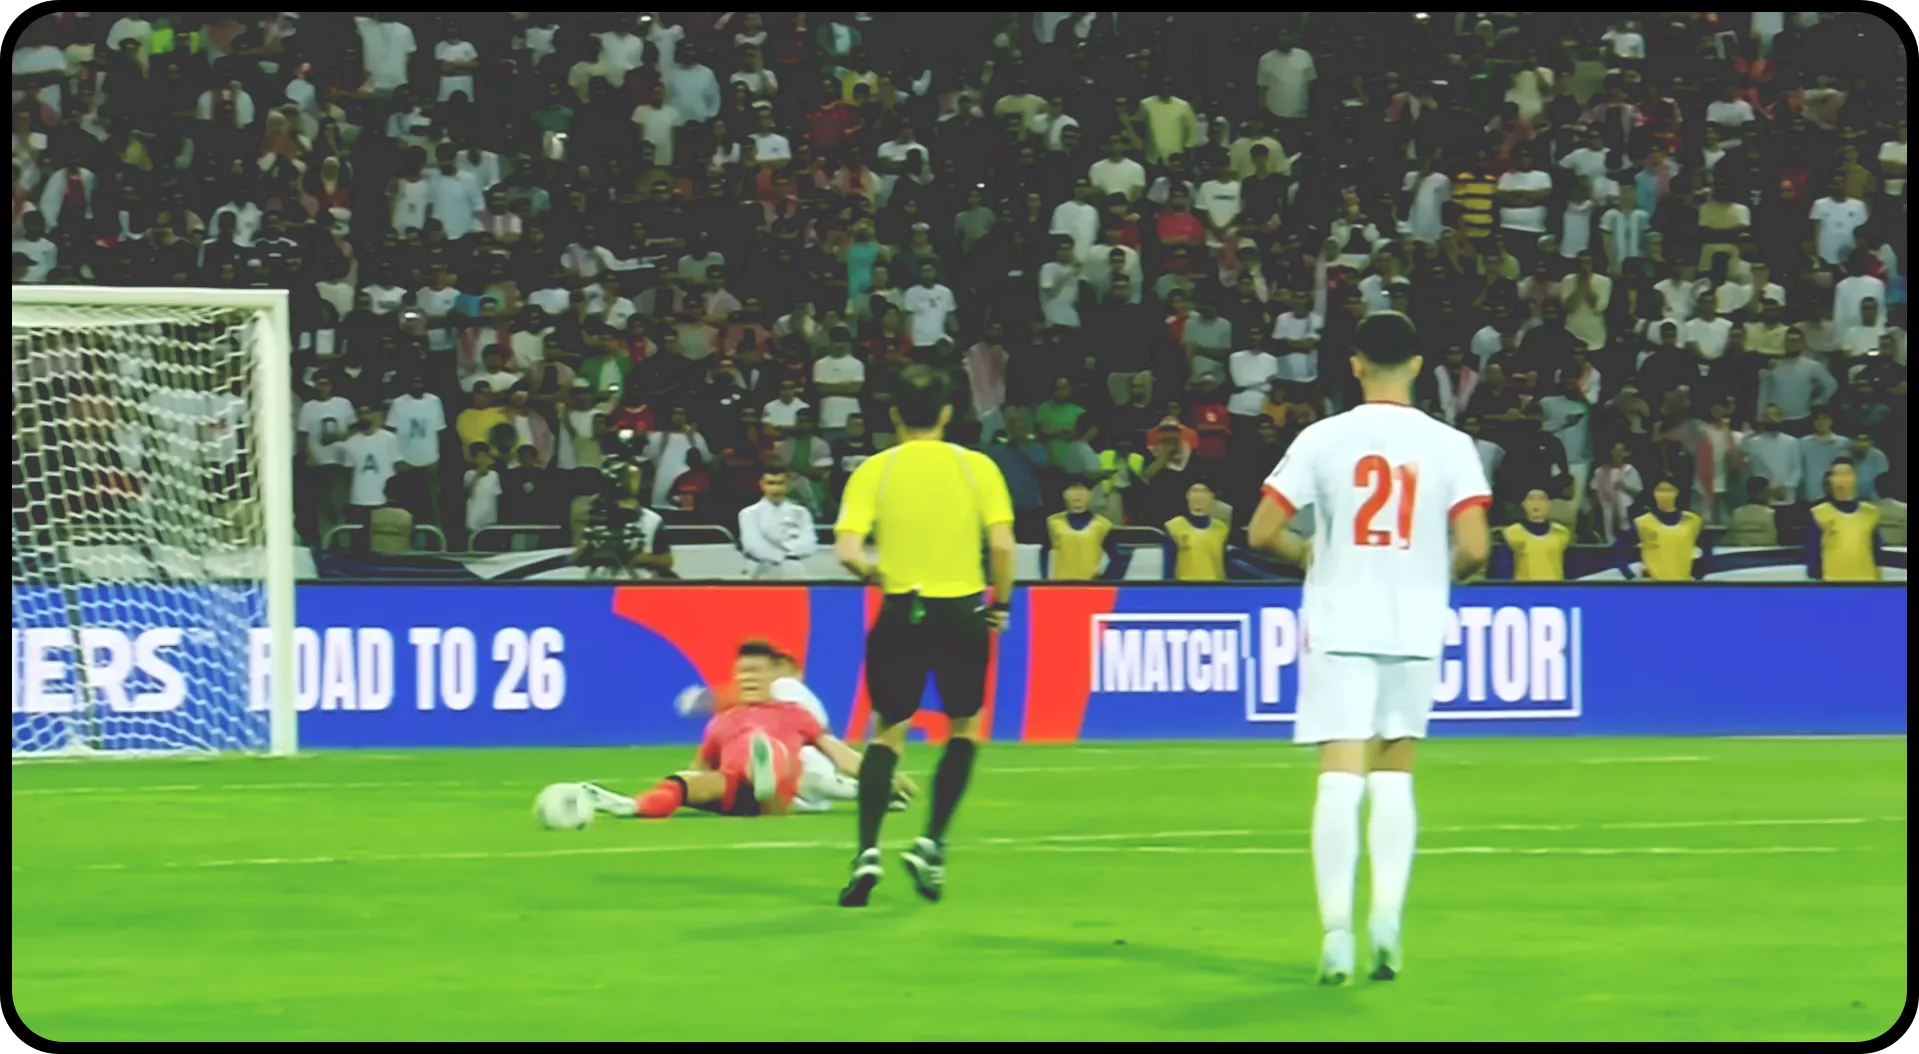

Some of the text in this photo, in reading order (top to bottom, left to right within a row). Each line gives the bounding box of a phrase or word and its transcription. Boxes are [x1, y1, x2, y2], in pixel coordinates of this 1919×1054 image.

[359, 452, 380, 475] A
[408, 417, 427, 439] N
[1353, 454, 1417, 549] 21
[408, 626, 476, 711] TO
[492, 626, 566, 711] 26
[1102, 628, 1239, 693] MATCH
[1259, 605, 1567, 704] PCTOR
